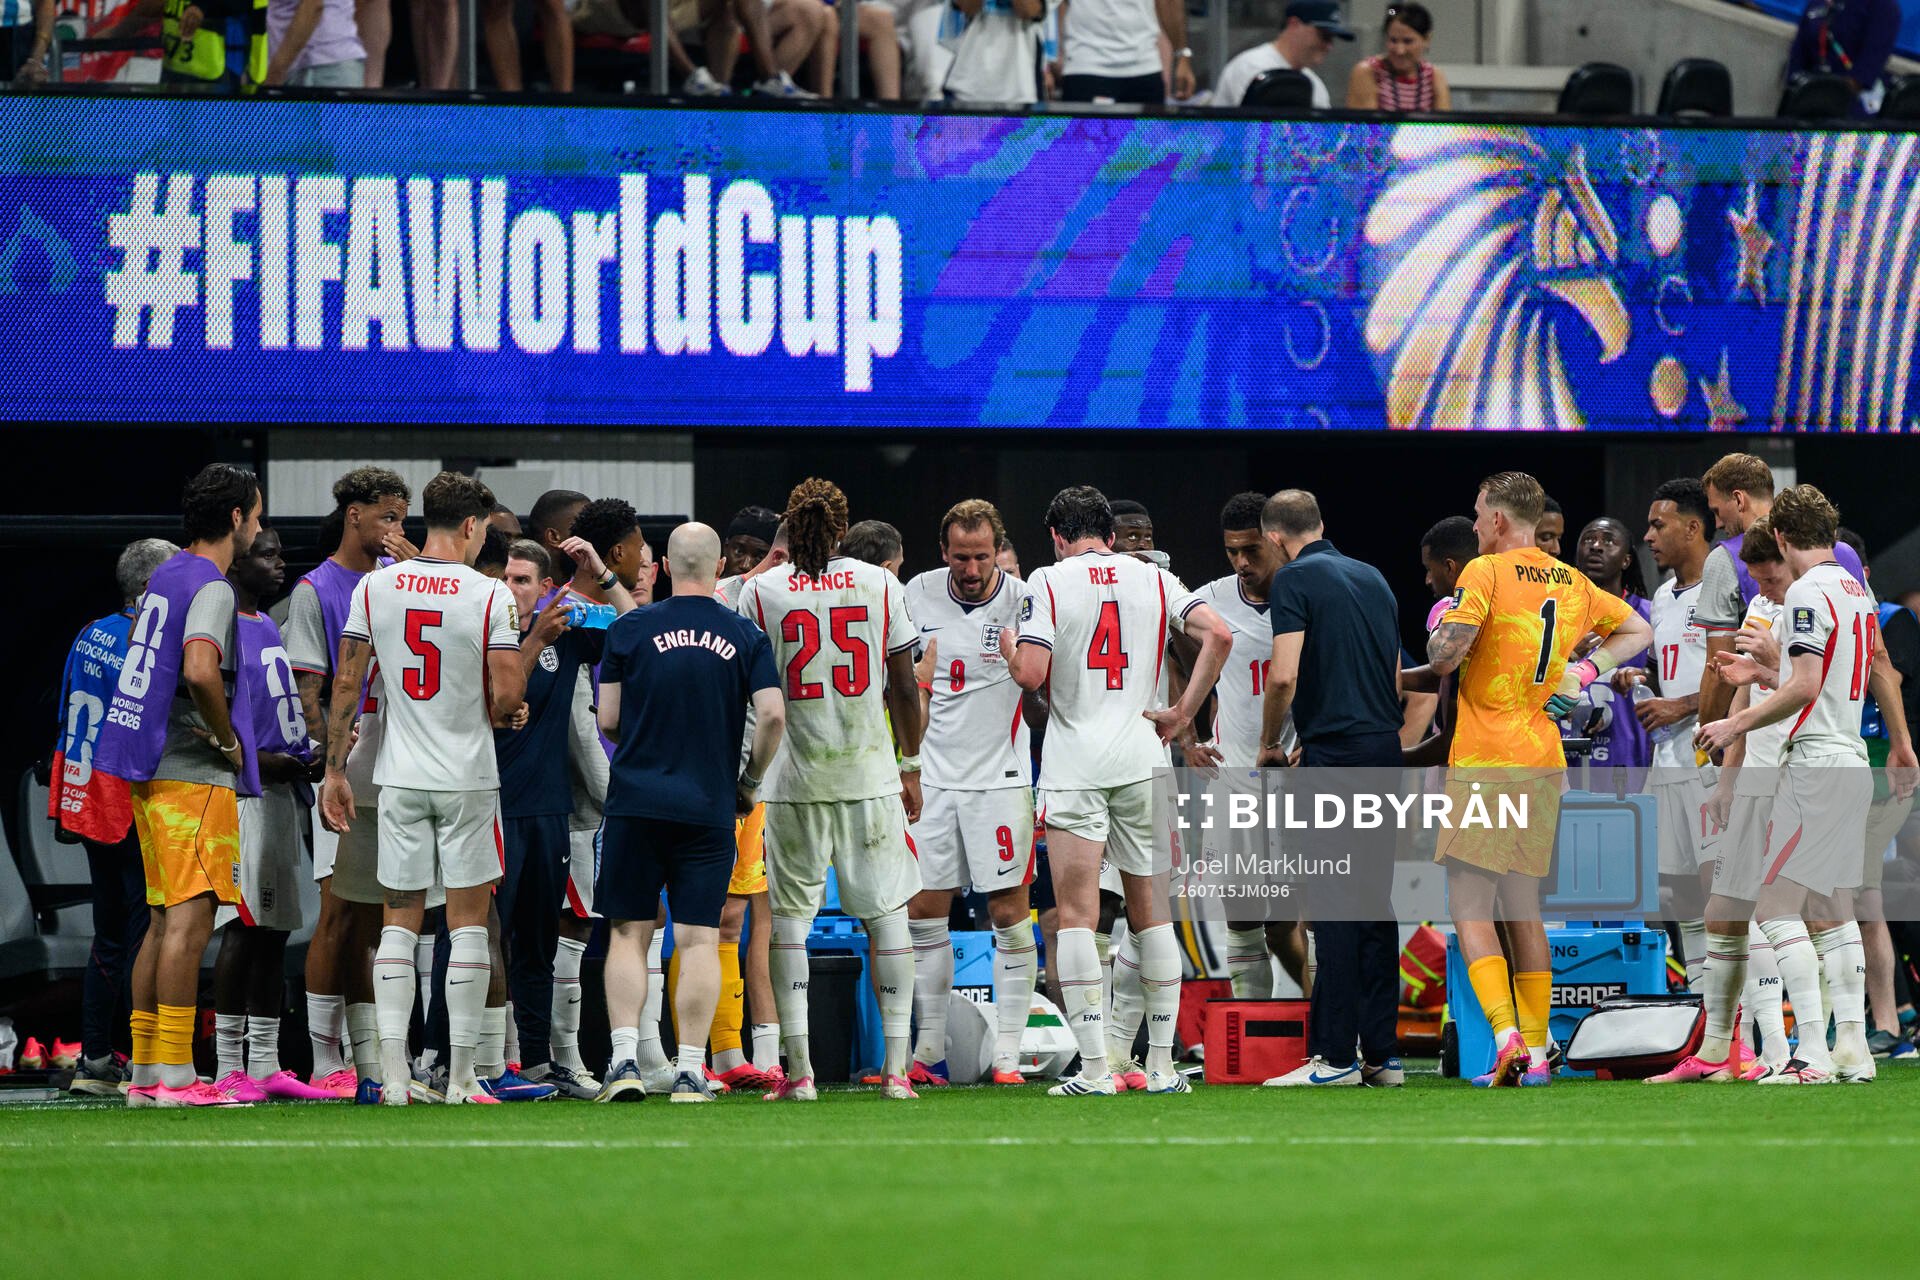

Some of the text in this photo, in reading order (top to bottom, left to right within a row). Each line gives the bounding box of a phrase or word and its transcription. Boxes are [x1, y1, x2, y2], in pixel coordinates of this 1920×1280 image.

[105, 172, 903, 391] #FIFAWorldCup
[395, 573, 460, 595] STONES
[788, 571, 855, 592] SPENCE
[1515, 565, 1573, 586] PICKFORD
[90, 627, 117, 648] TEAM
[653, 629, 736, 660] ENGLAND
[1087, 600, 1128, 690] 4
[1533, 598, 1557, 685] 1
[75, 639, 125, 671] OTOGRAPHE
[402, 608, 443, 700] 5
[780, 605, 870, 700] 25
[1662, 644, 1679, 680] 17
[83, 660, 102, 679] ENG
[950, 659, 966, 692] 9
[106, 708, 141, 730] 2026
[65, 765, 81, 777] IFA
[61, 797, 83, 814] 26
[995, 825, 1015, 862] 9
[1856, 965, 1866, 974] EN
[880, 985, 898, 995] ENG
[1759, 976, 1779, 987] ENG
[1550, 985, 1622, 1006] ERADE
[1083, 1013, 1101, 1022] ENG
[1152, 1014, 1171, 1022] ENG
